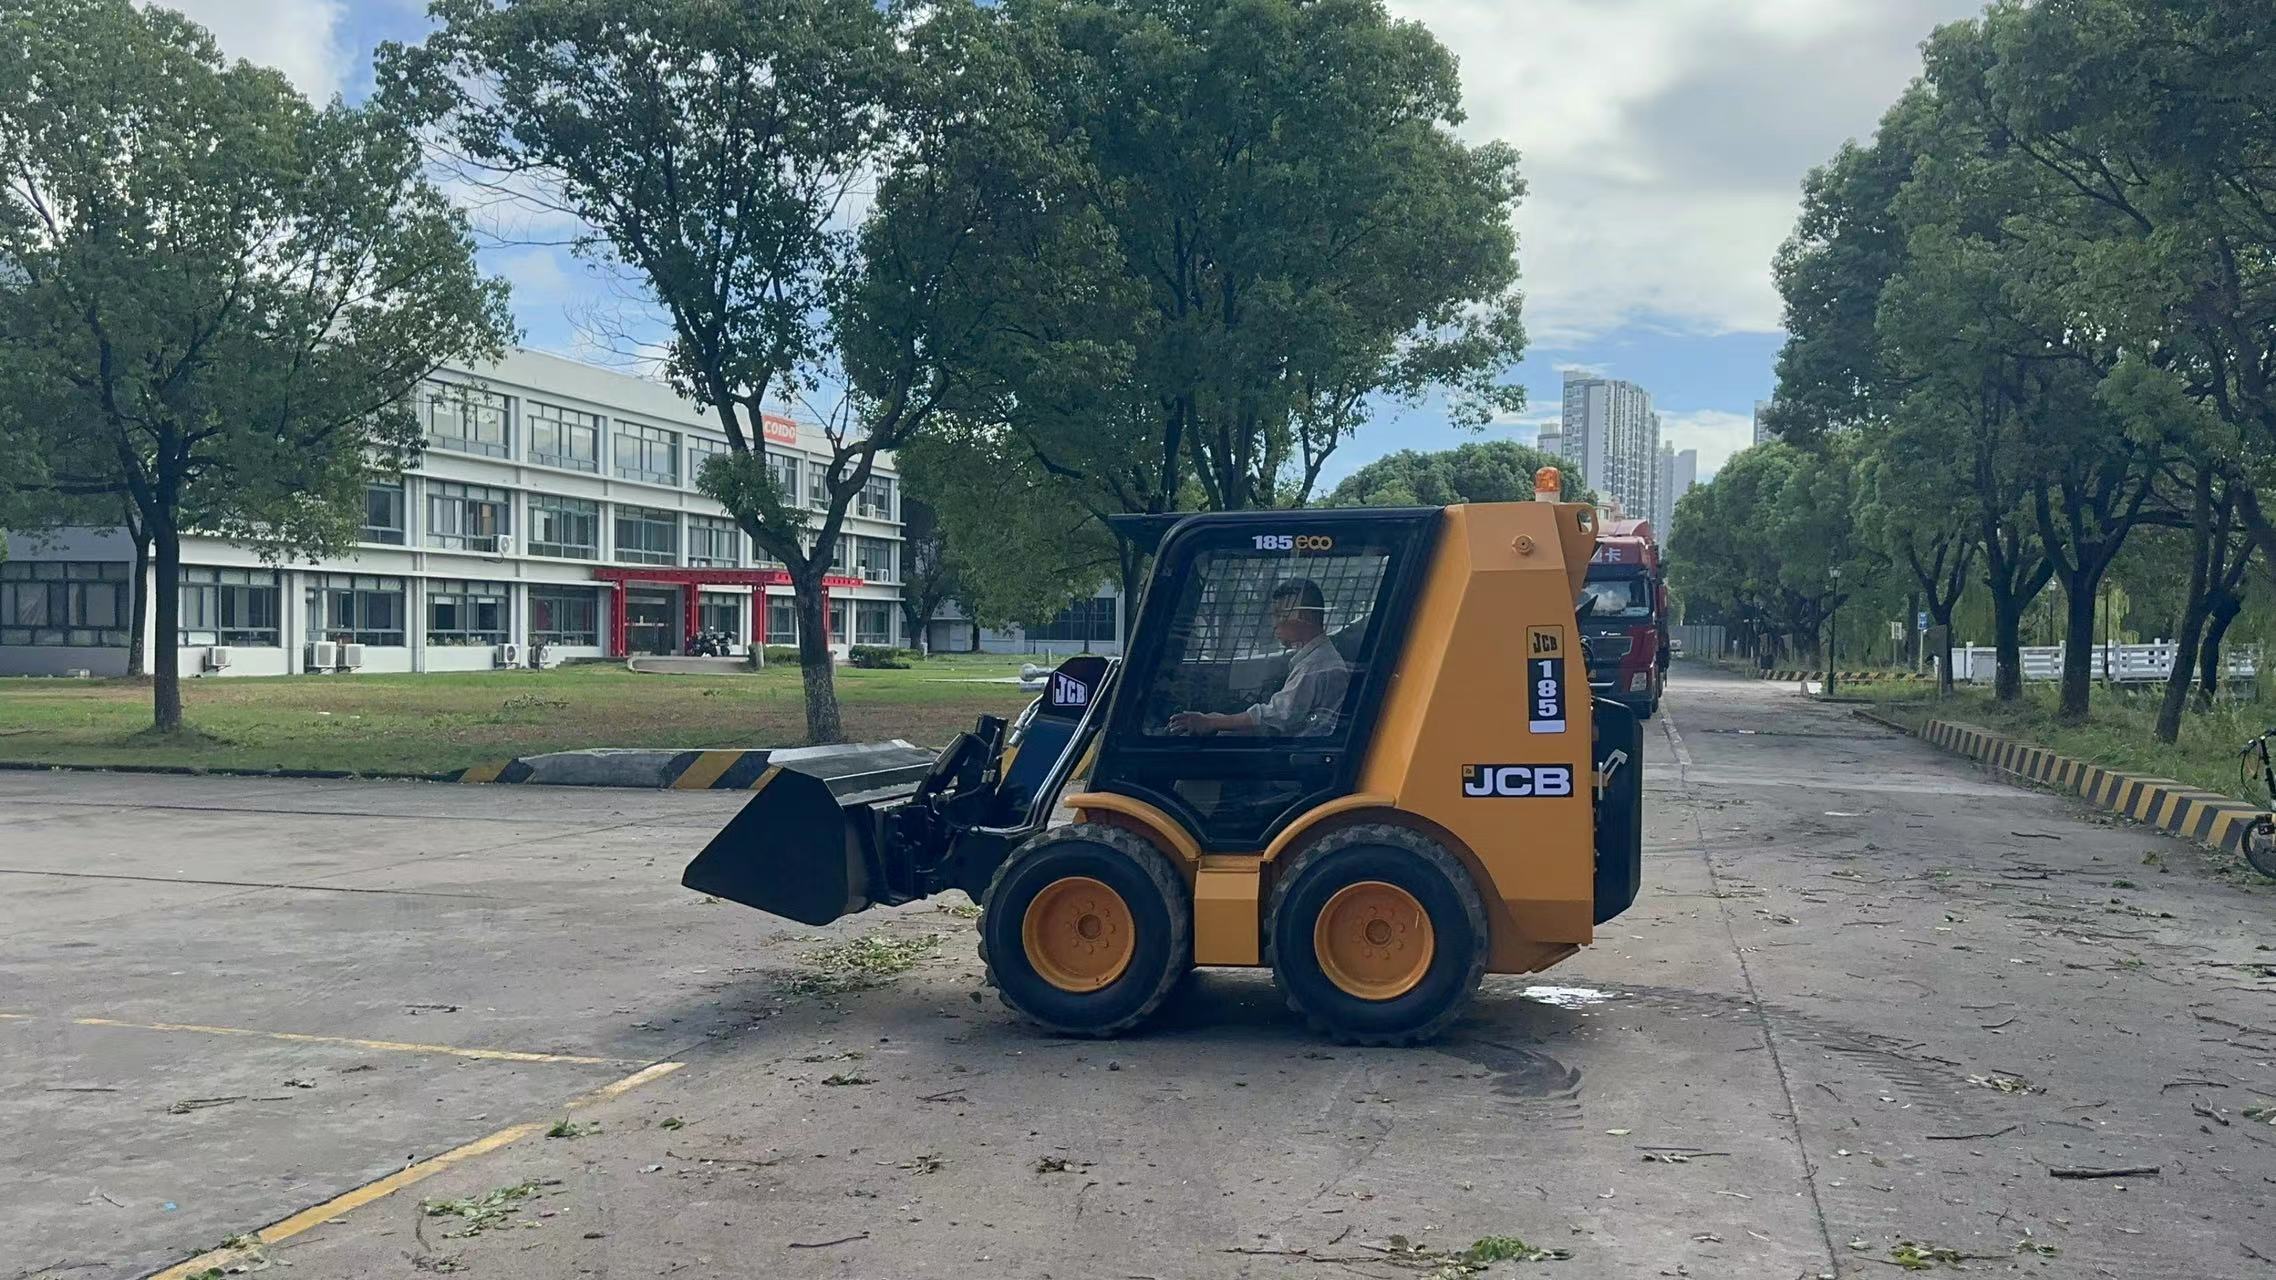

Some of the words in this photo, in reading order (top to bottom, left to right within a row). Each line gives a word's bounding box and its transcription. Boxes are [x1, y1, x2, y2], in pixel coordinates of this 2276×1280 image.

[1533, 631, 1558, 654] JCB
[1055, 675, 1085, 704] JCB
[1537, 660, 1558, 717] 185
[1465, 767, 1571, 796] JCB
